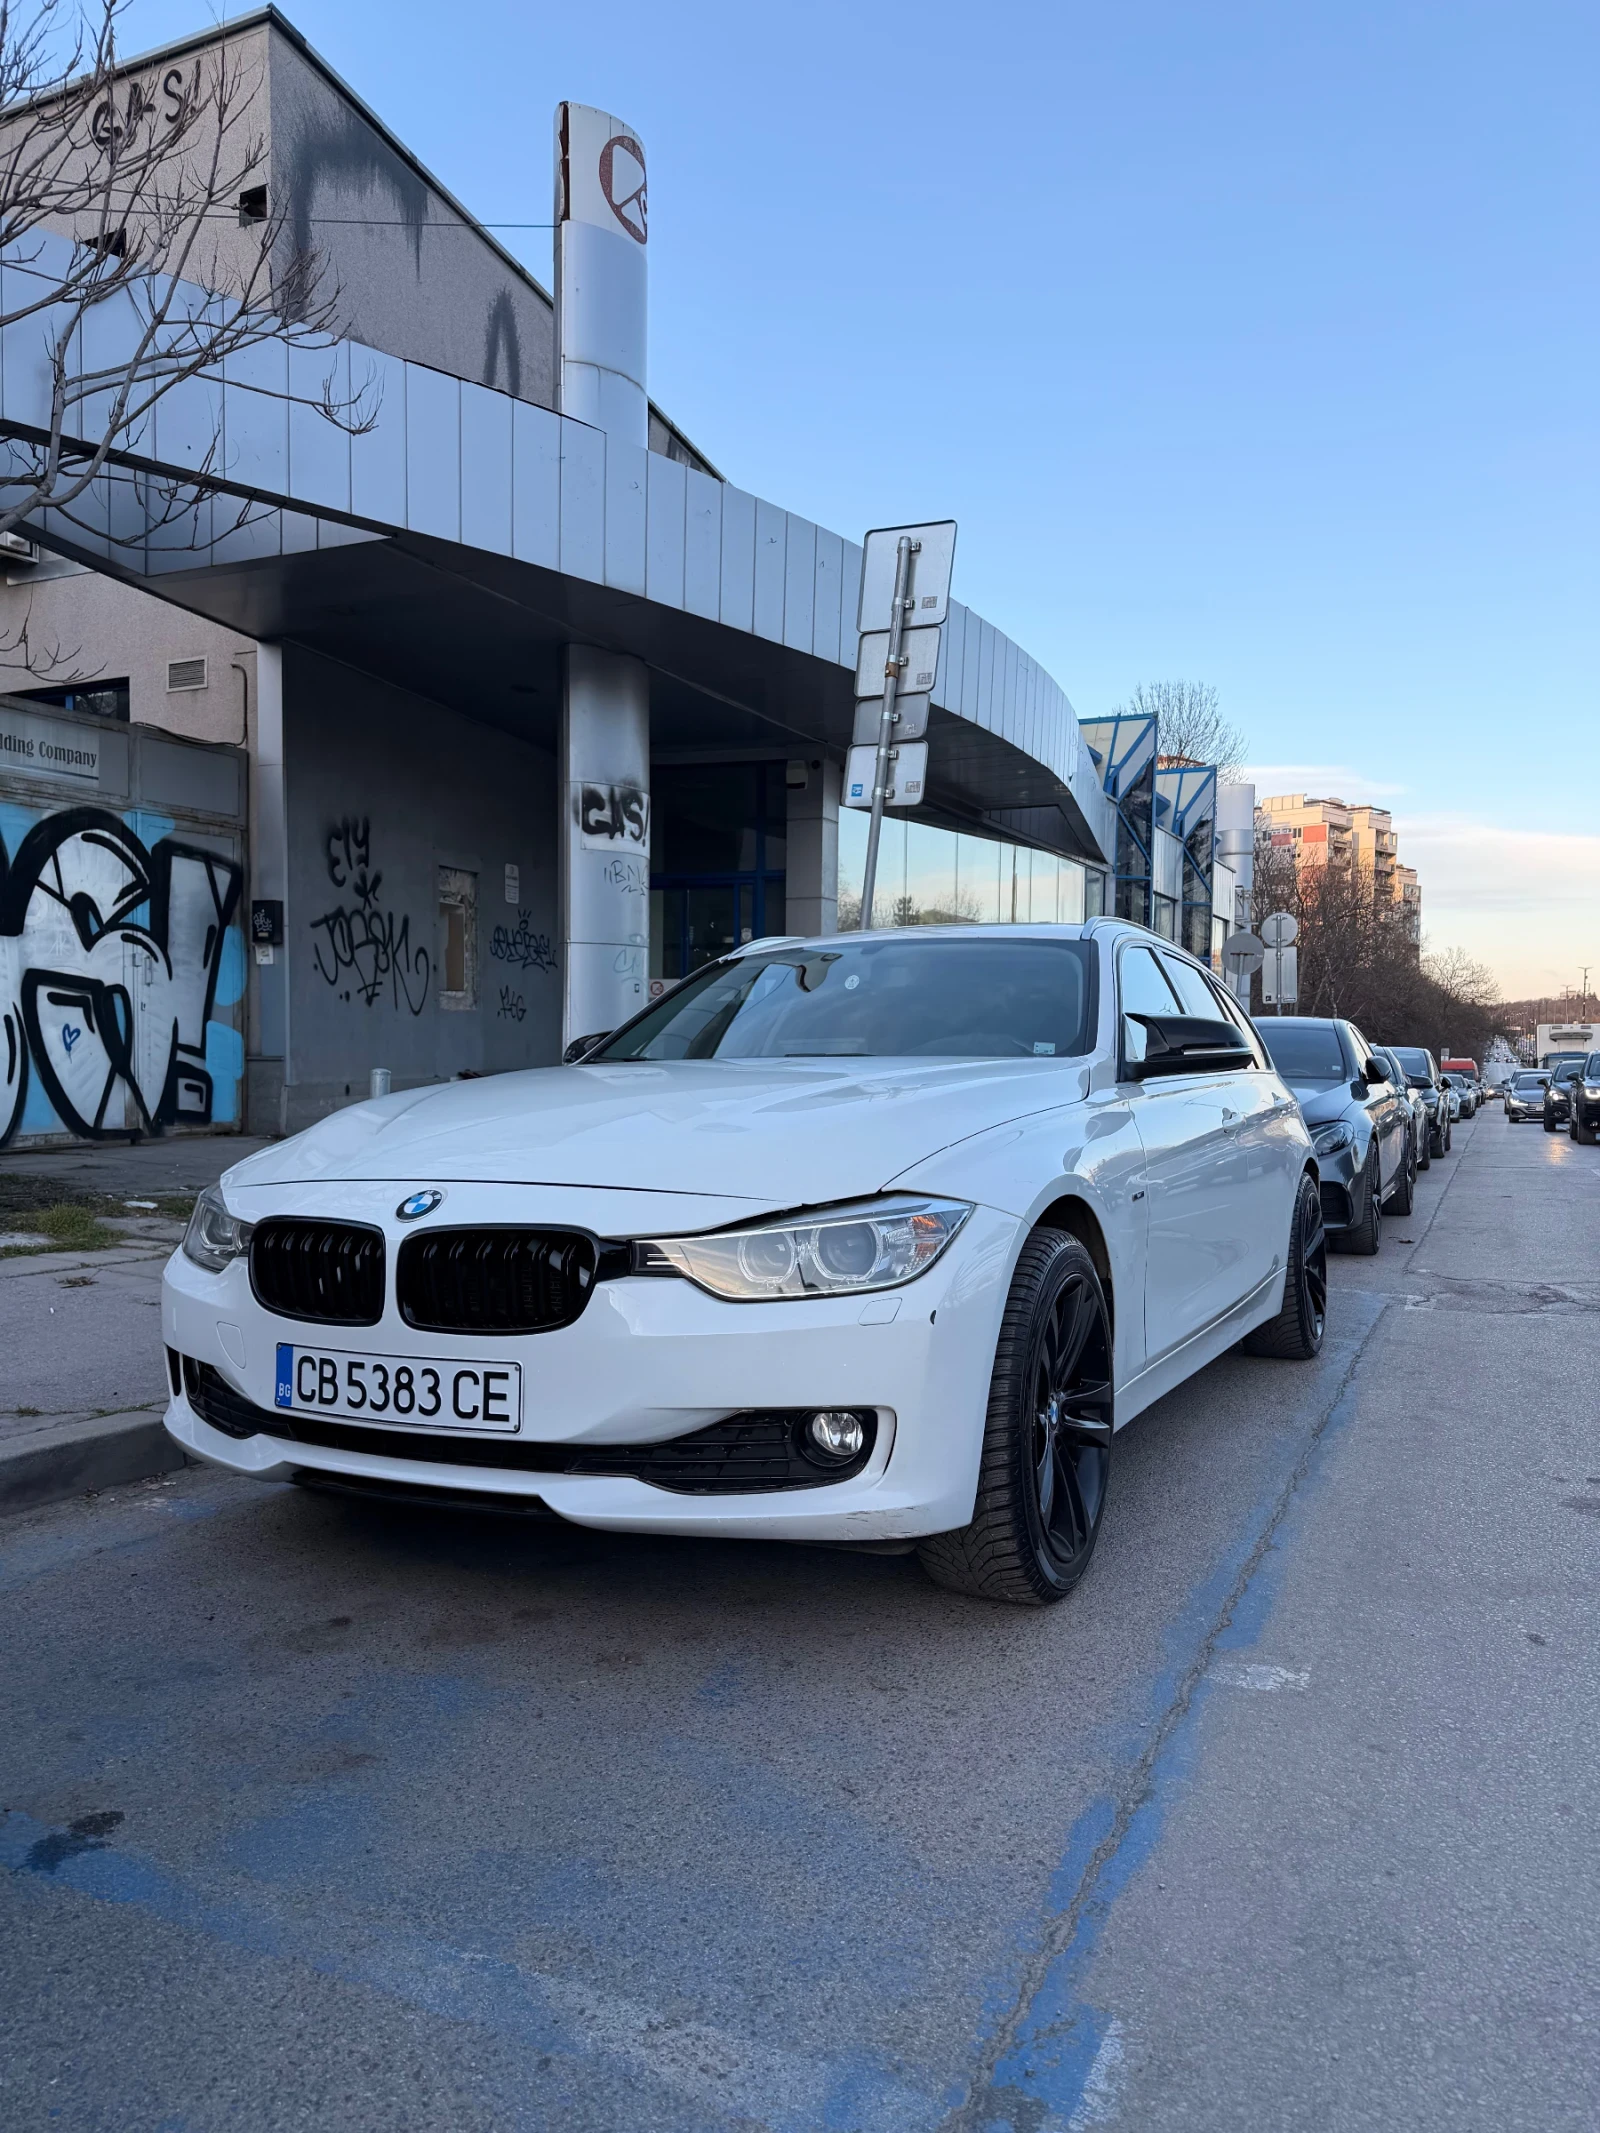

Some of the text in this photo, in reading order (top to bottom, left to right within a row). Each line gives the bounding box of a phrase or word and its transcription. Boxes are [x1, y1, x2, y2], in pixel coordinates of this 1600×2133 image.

[39, 741, 97, 768] Company
[278, 1382, 291, 1398] BG
[297, 1355, 510, 1423] CB 5383 CE
